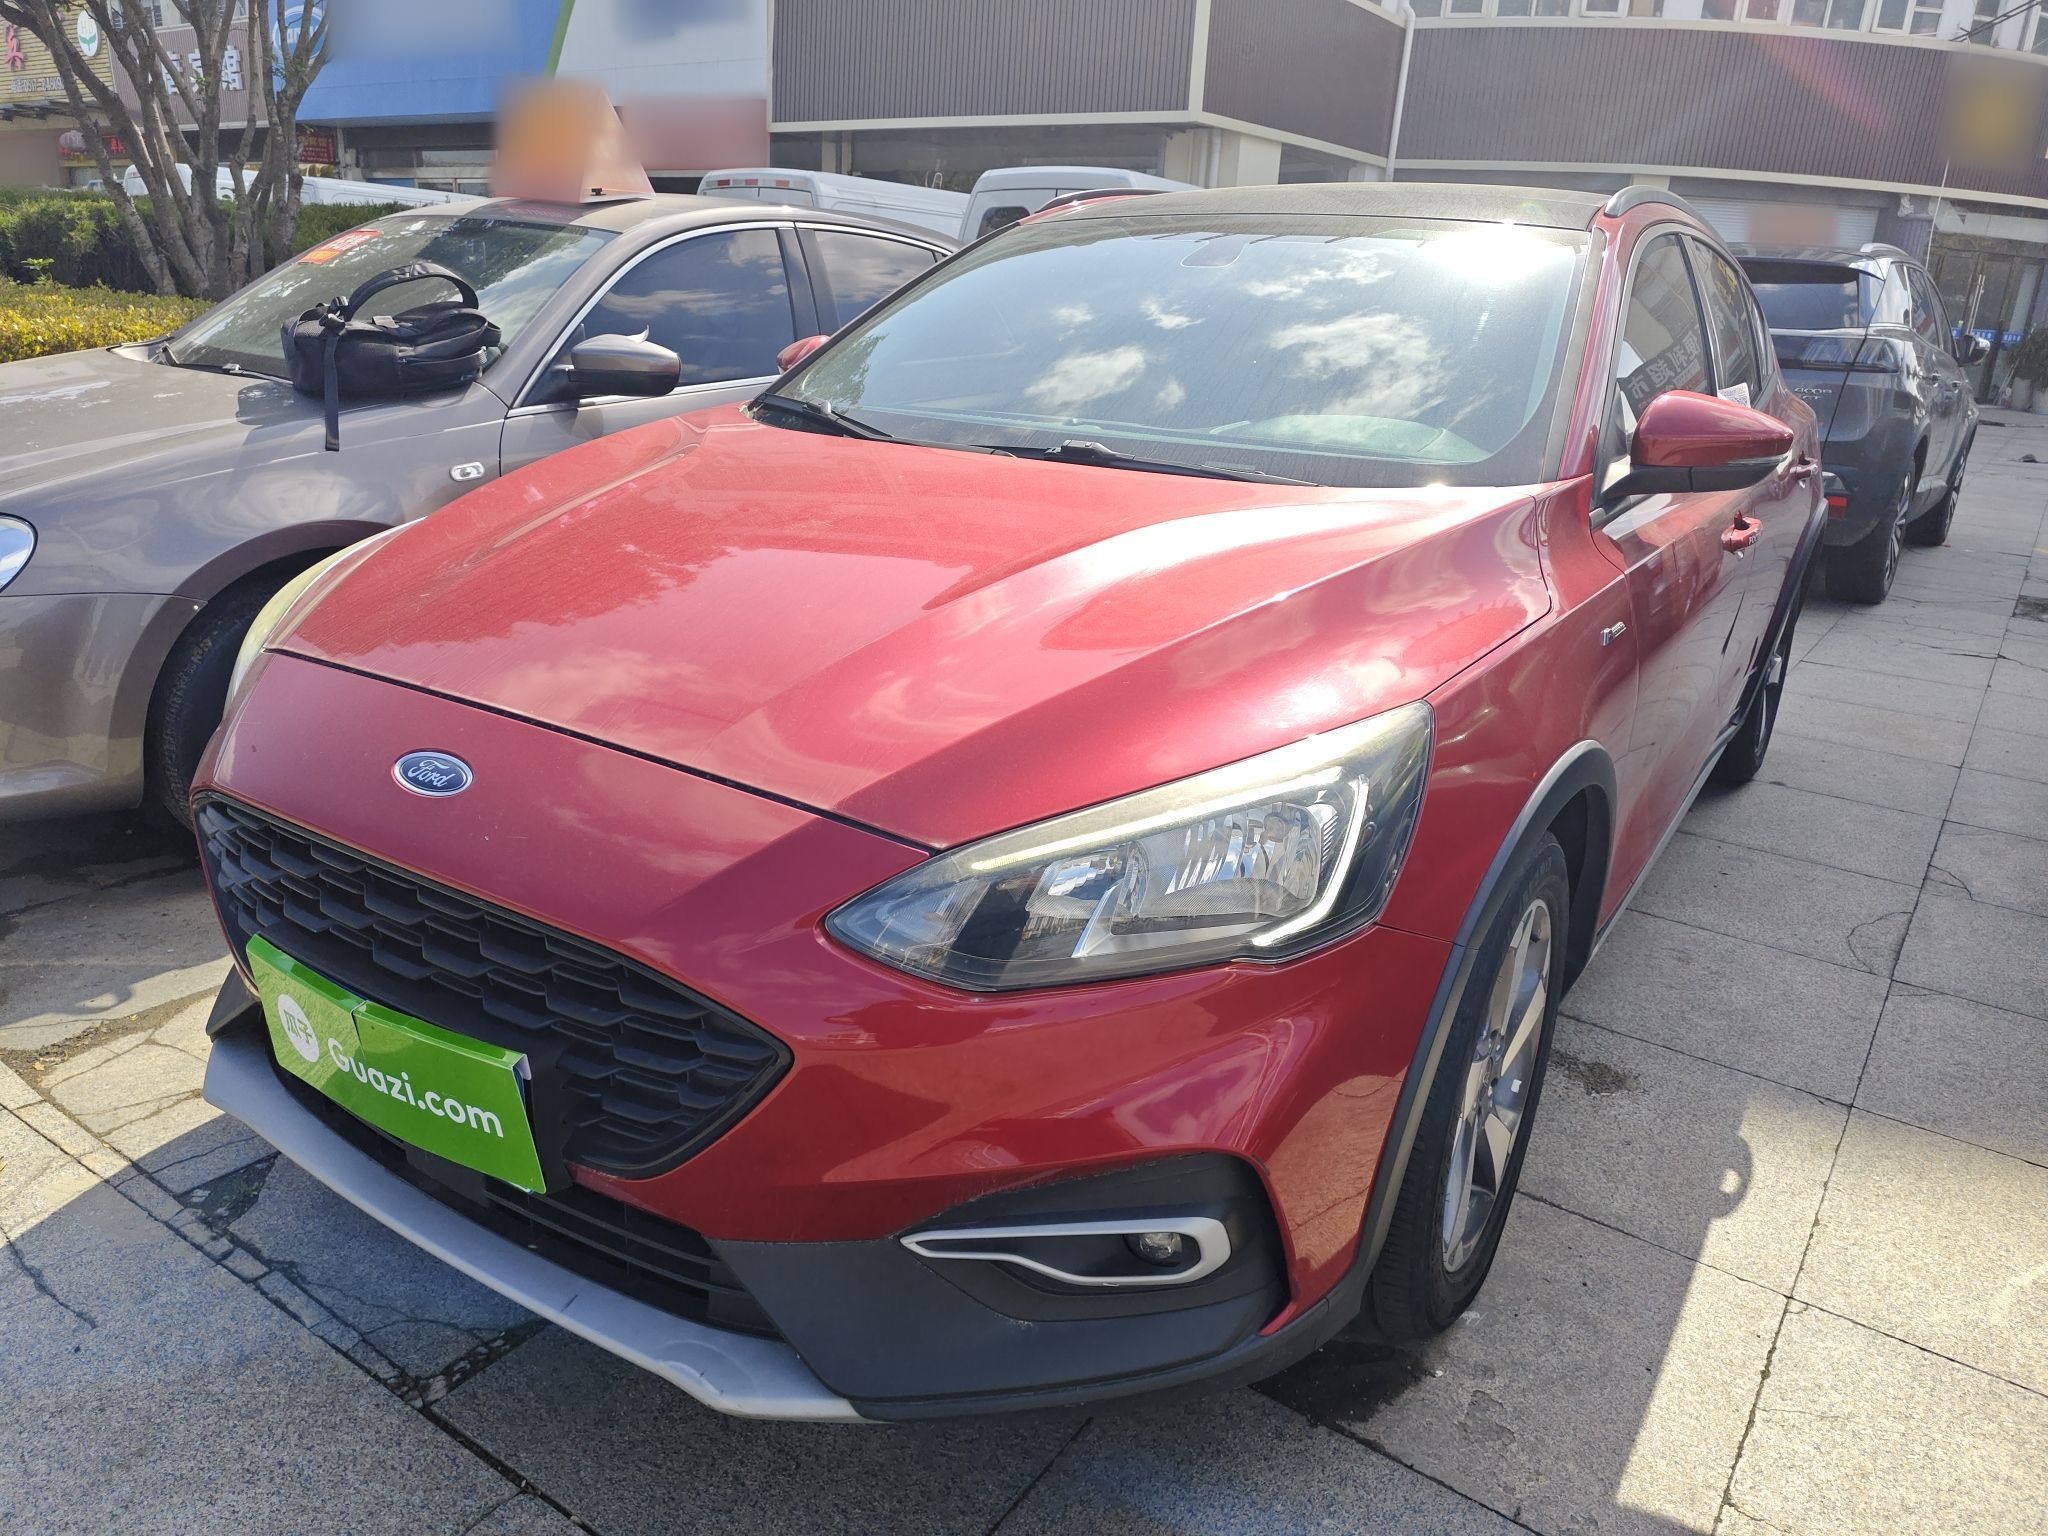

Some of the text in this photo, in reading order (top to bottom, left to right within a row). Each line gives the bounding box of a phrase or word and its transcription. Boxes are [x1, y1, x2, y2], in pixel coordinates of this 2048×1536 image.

[407, 759, 456, 787] Ford
[283, 1009, 313, 1045] 瓜子
[327, 1037, 504, 1138] Guazi.com
